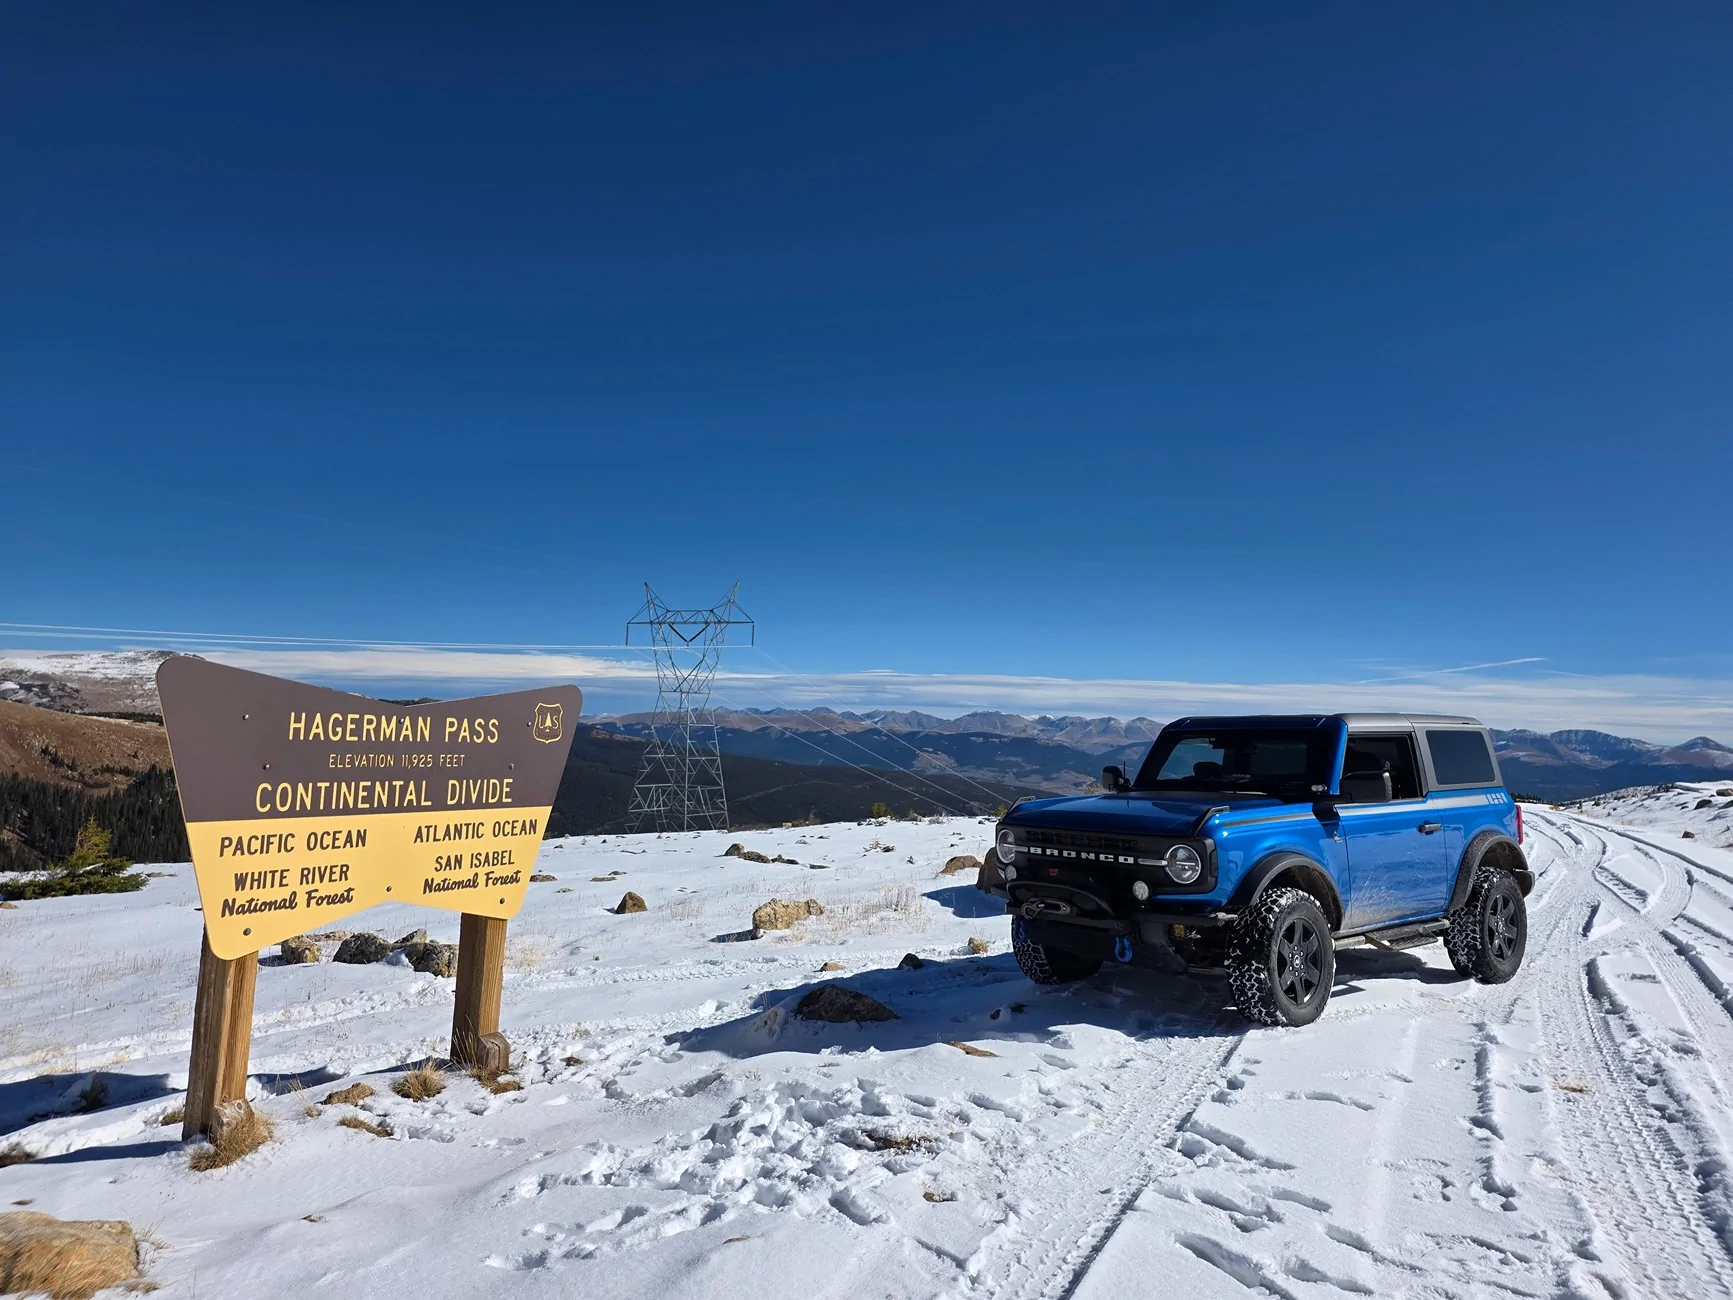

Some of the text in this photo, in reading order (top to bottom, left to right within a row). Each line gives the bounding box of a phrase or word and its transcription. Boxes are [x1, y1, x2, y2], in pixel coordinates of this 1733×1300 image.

[288, 711, 500, 744] HAGERMAN PASS
[329, 753, 466, 769] ELEVATION 11,925 FEET
[255, 777, 514, 814] CONTINENTAL DIVIDE
[219, 828, 368, 858] PACIFIC OCEAN
[413, 818, 539, 844] ATLANTIC OCEAN
[434, 849, 515, 873] SAN ISABEL
[1029, 846, 1135, 864] BRONCO
[234, 863, 350, 892] WHITE RIVER
[422, 869, 522, 895] National Forest
[220, 887, 355, 919] National Forest
